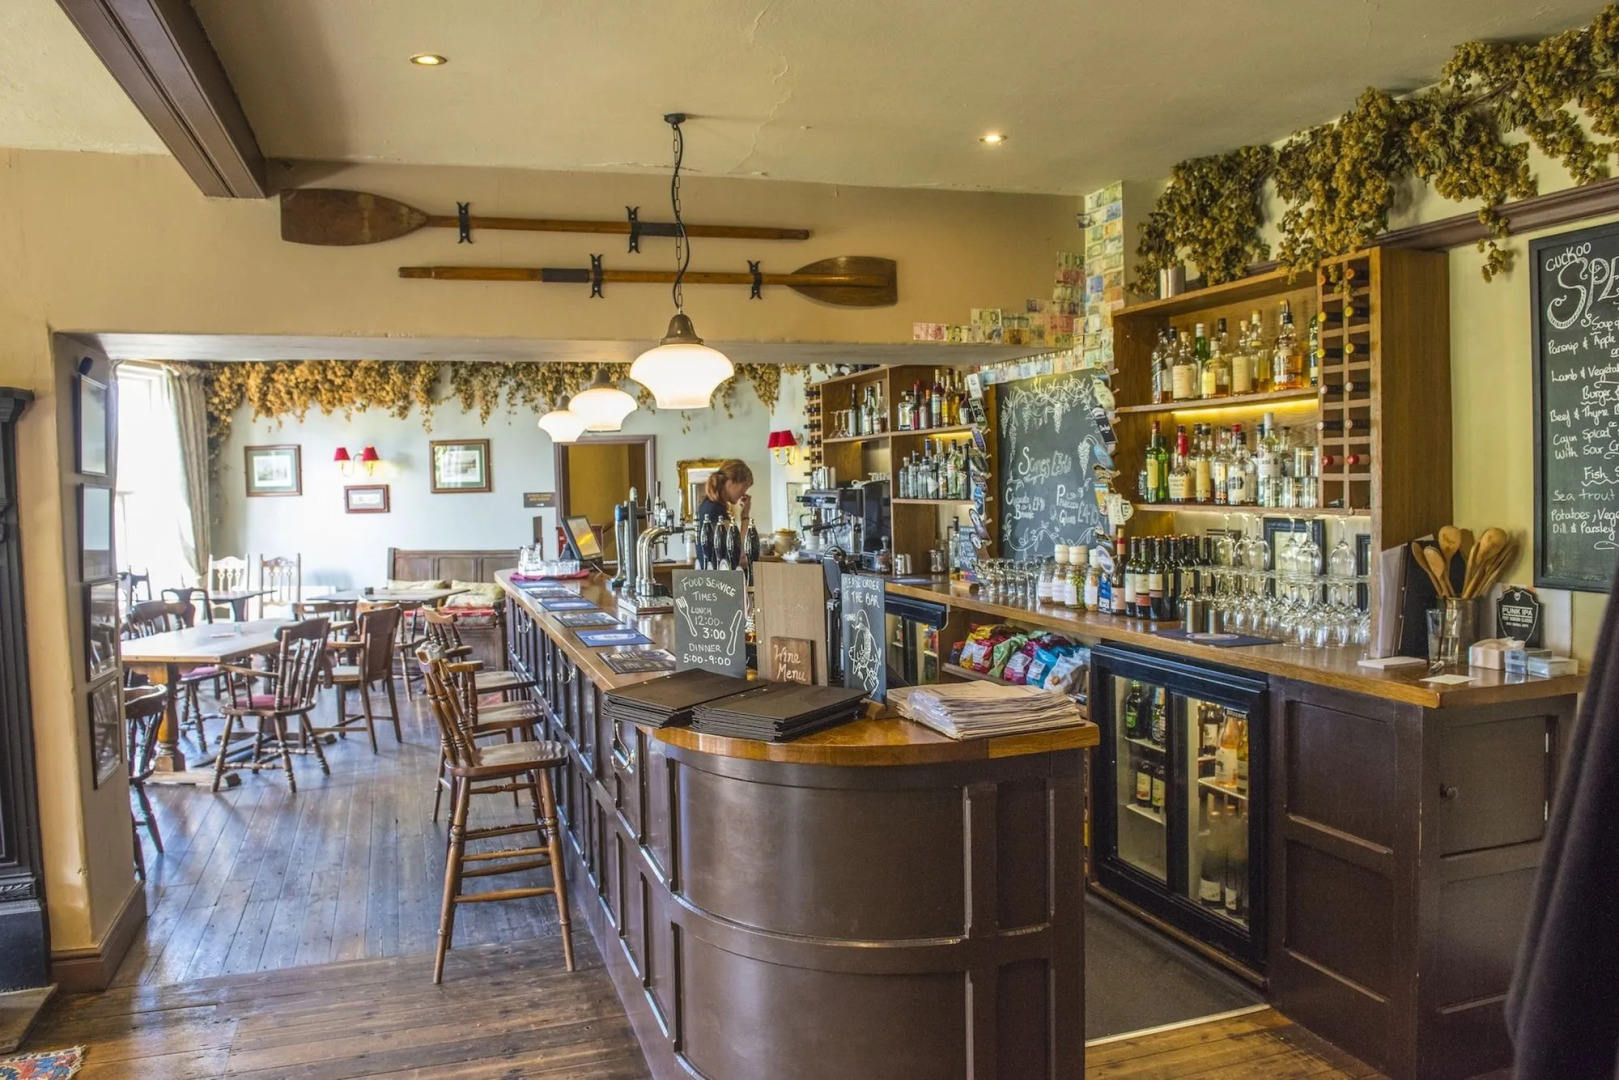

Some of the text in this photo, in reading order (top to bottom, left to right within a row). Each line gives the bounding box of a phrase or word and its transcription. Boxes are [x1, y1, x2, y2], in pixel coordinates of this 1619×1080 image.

[1591, 316, 1614, 332] Soup
[1548, 339, 1579, 355] Parsnip
[1593, 332, 1617, 350] Apple
[1551, 368, 1578, 383] Lamb
[1582, 385, 1611, 407] Burger
[1549, 409, 1571, 428] Beef
[1581, 404, 1610, 426] Thyme
[1552, 427, 1612, 451] Cajun Spiced
[1554, 447, 1579, 460] With
[1582, 444, 1604, 456] Sour
[1583, 466, 1608, 480] Fish
[1552, 488, 1616, 502] Sea trout
[1552, 522, 1567, 534] Dill
[1580, 520, 1616, 541] Parsley
[681, 576, 704, 591] FOOD
[862, 579, 881, 593] ORDER
[692, 590, 718, 602] TIMES
[851, 590, 864, 604] THE
[865, 592, 880, 609] BAR
[690, 606, 712, 616] LUNCH
[1502, 607, 1521, 615] PUNK
[702, 627, 726, 640] 3:00
[688, 642, 722, 653] DINNER
[773, 644, 801, 664] Wine
[776, 662, 807, 682] Menu
